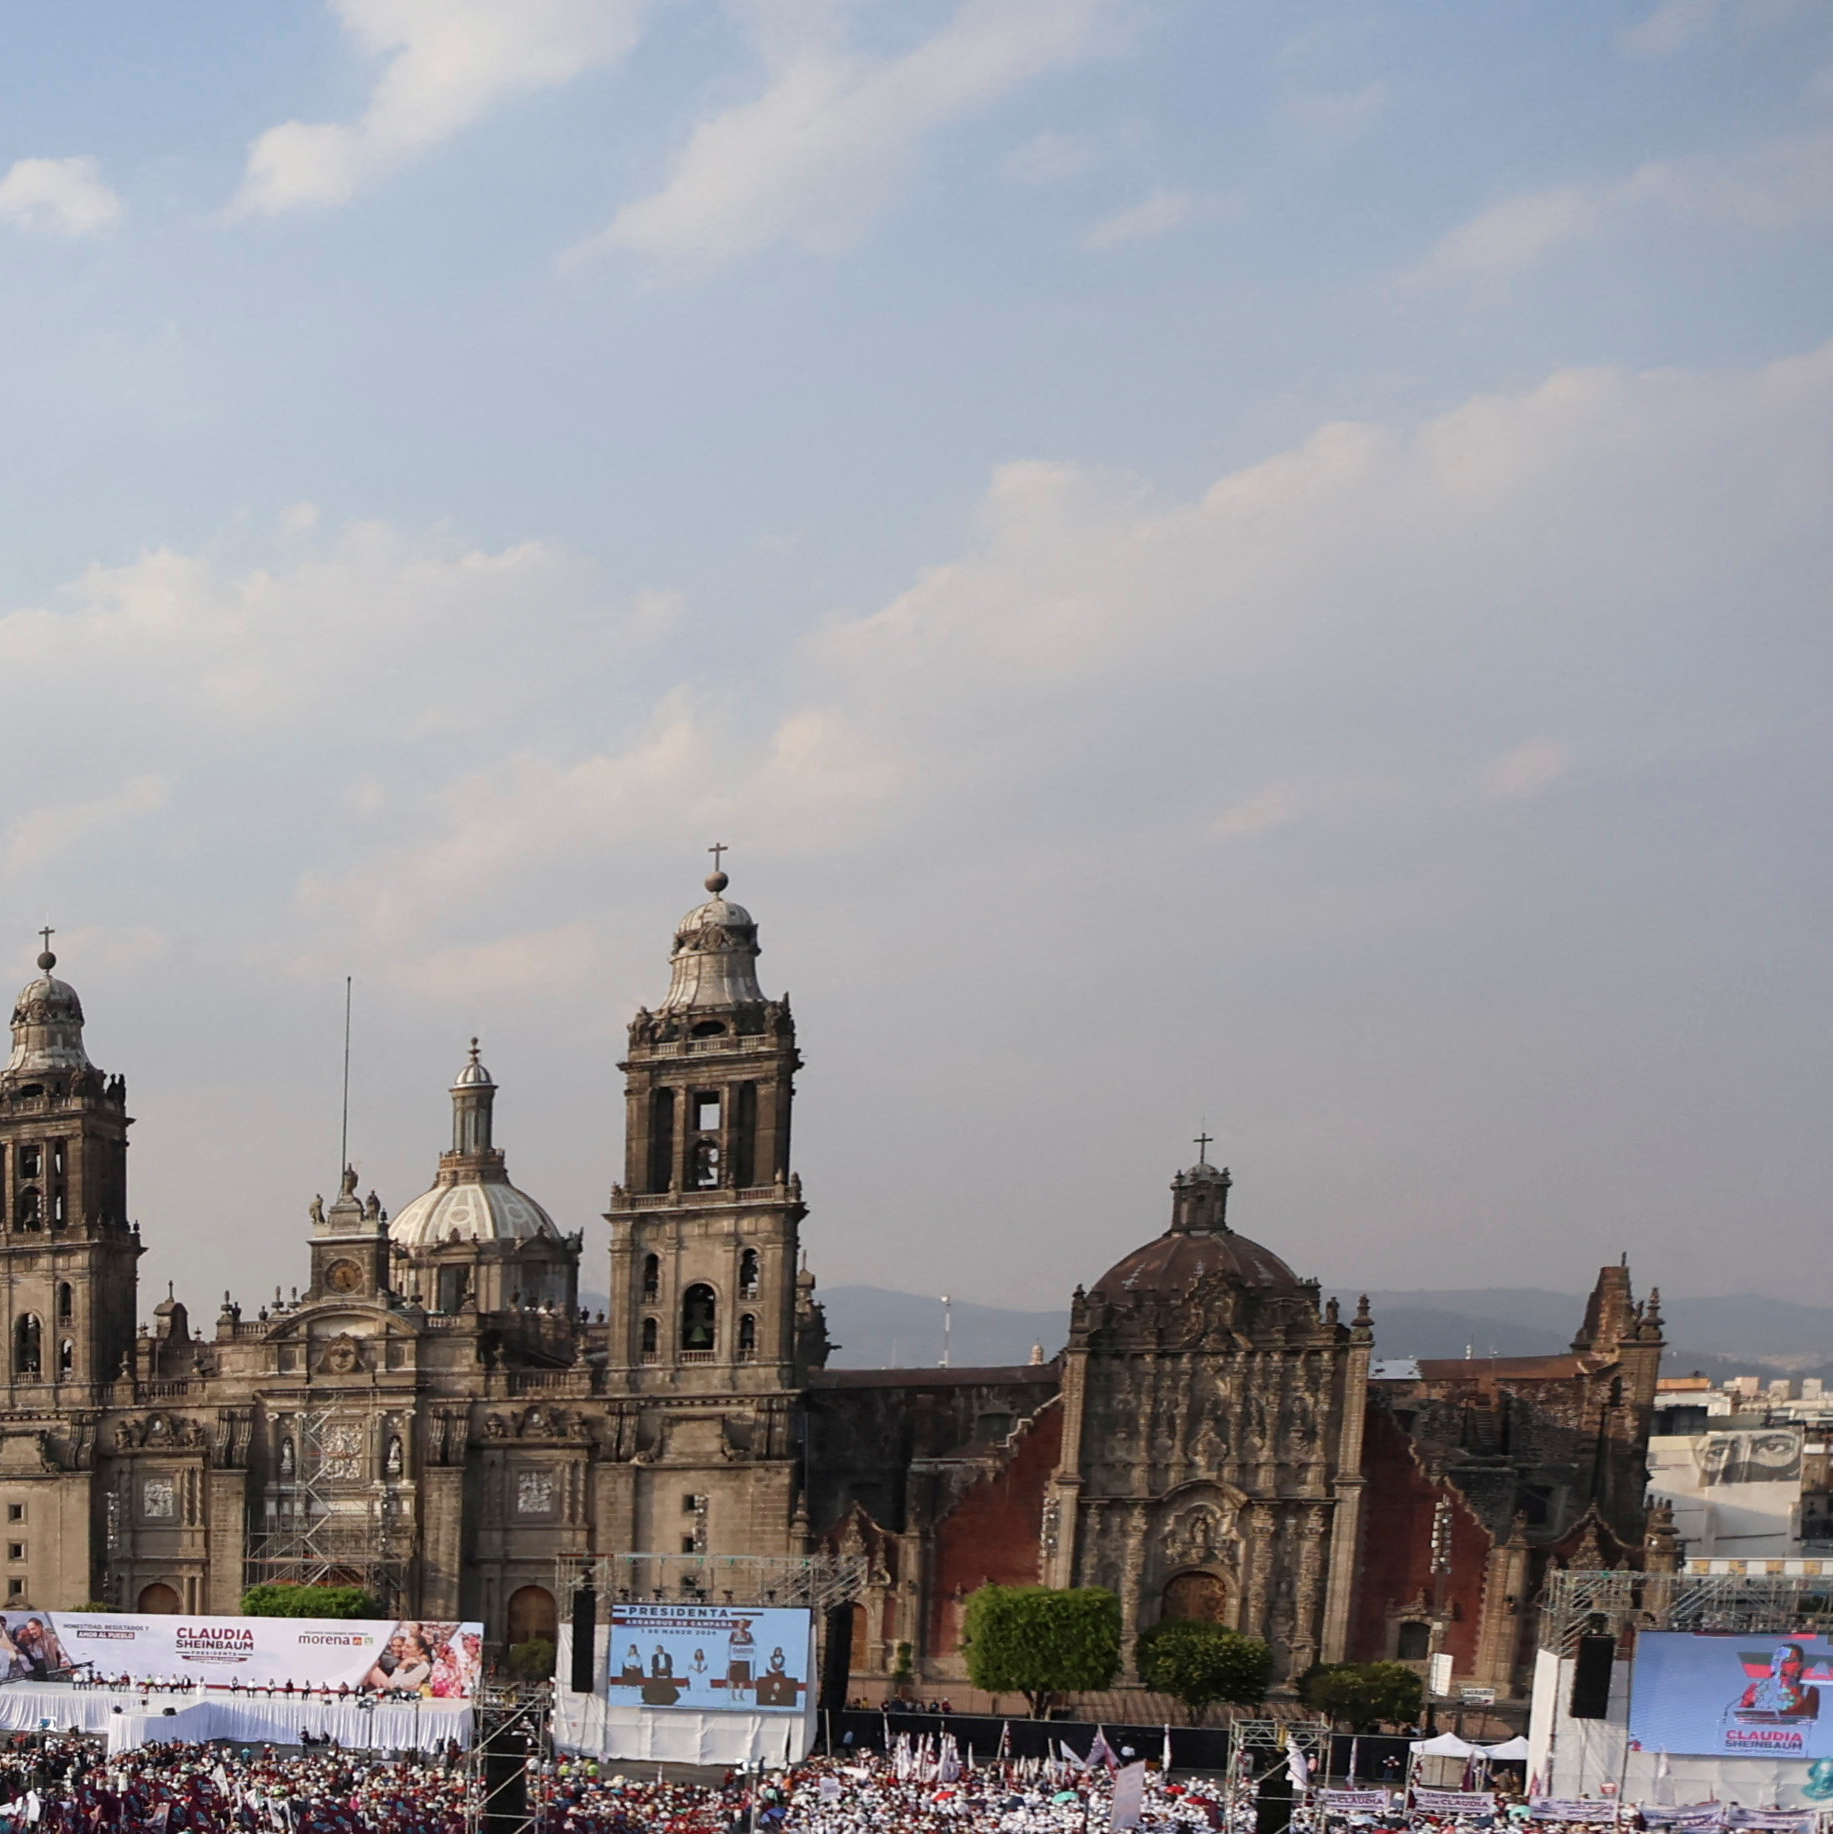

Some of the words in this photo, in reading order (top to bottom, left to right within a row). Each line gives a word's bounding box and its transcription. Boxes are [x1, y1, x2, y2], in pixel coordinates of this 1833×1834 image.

[628, 1606, 729, 1618] PRESIDENTA
[177, 1627, 254, 1641] CLAUDIA
[298, 1635, 350, 1645] morena
[176, 1639, 254, 1651] SHEINBAUM
[1725, 1729, 1803, 1741] CLAUDIA
[1725, 1739, 1803, 1750] SHEINBAUM
